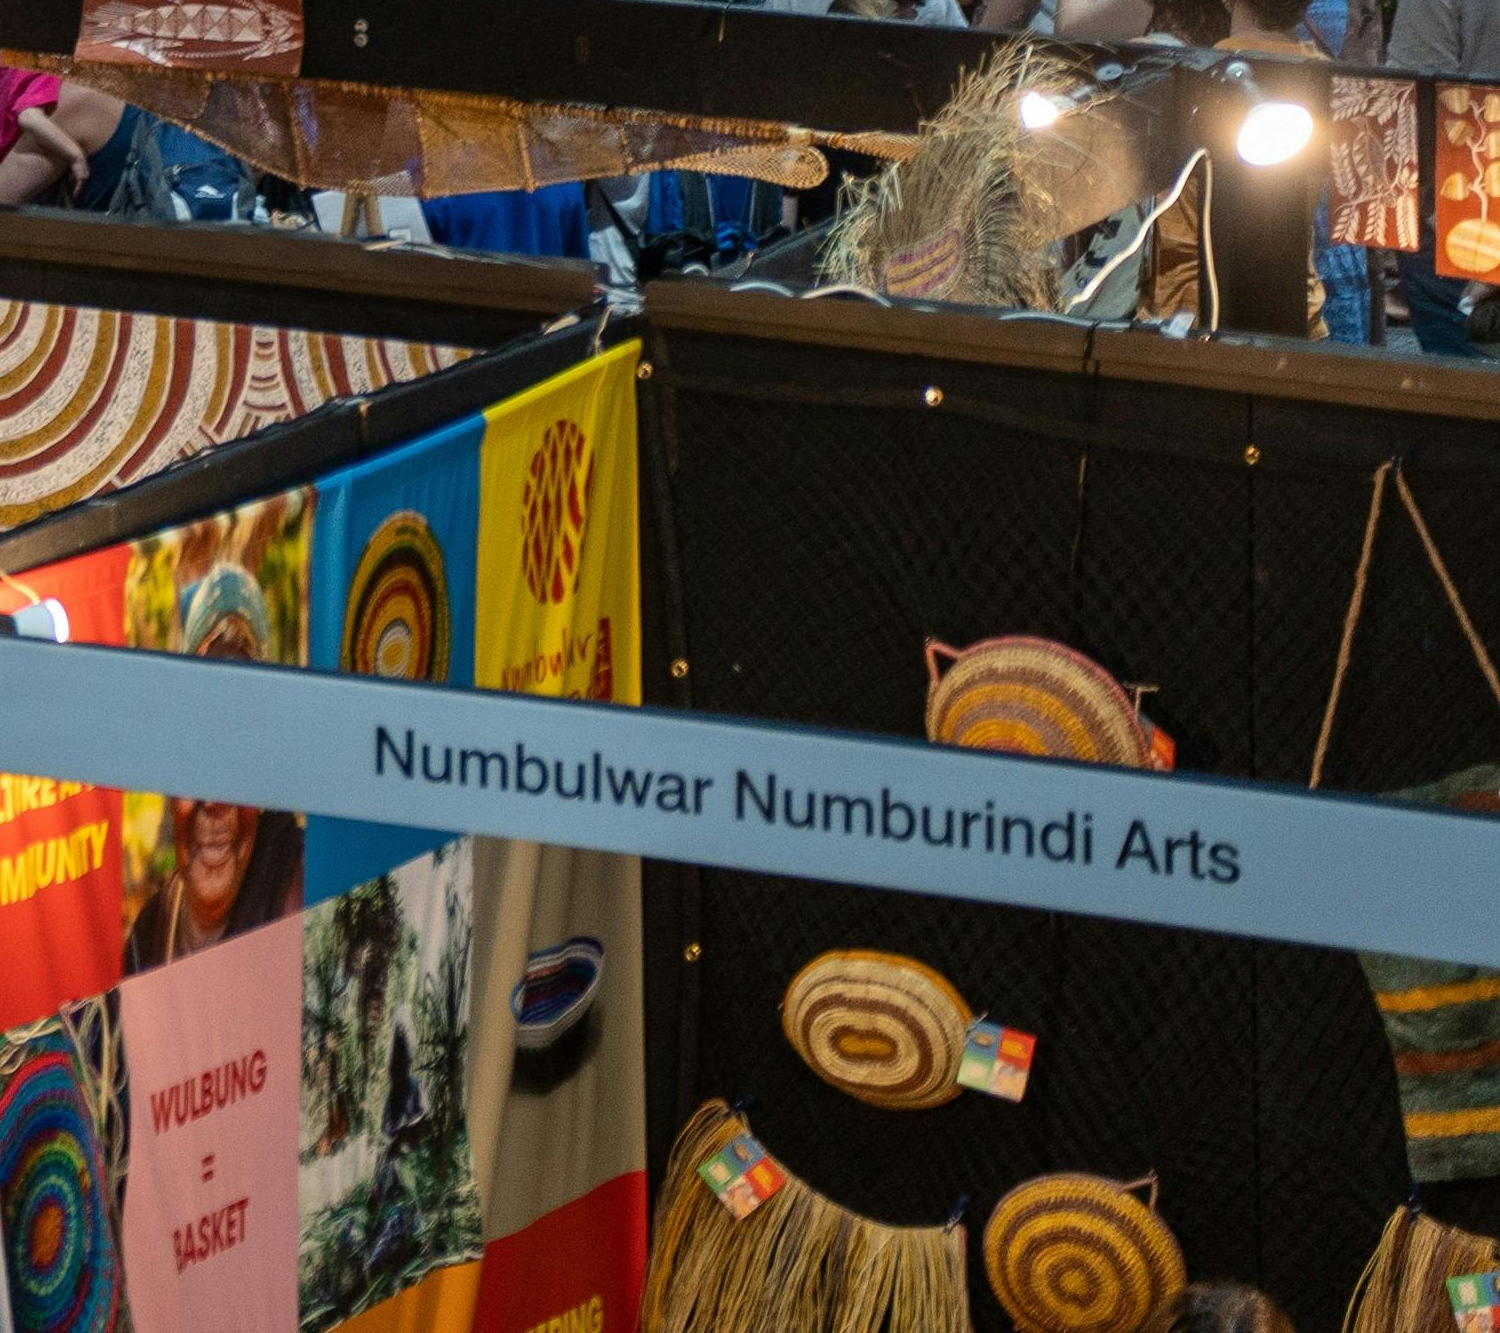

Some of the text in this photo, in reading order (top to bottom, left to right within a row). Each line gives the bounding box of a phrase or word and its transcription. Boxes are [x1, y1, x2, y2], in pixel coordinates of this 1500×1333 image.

[374, 726, 1242, 885] Numbulwar Numburindi Arts
[150, 1048, 269, 1137] WULBUNG
